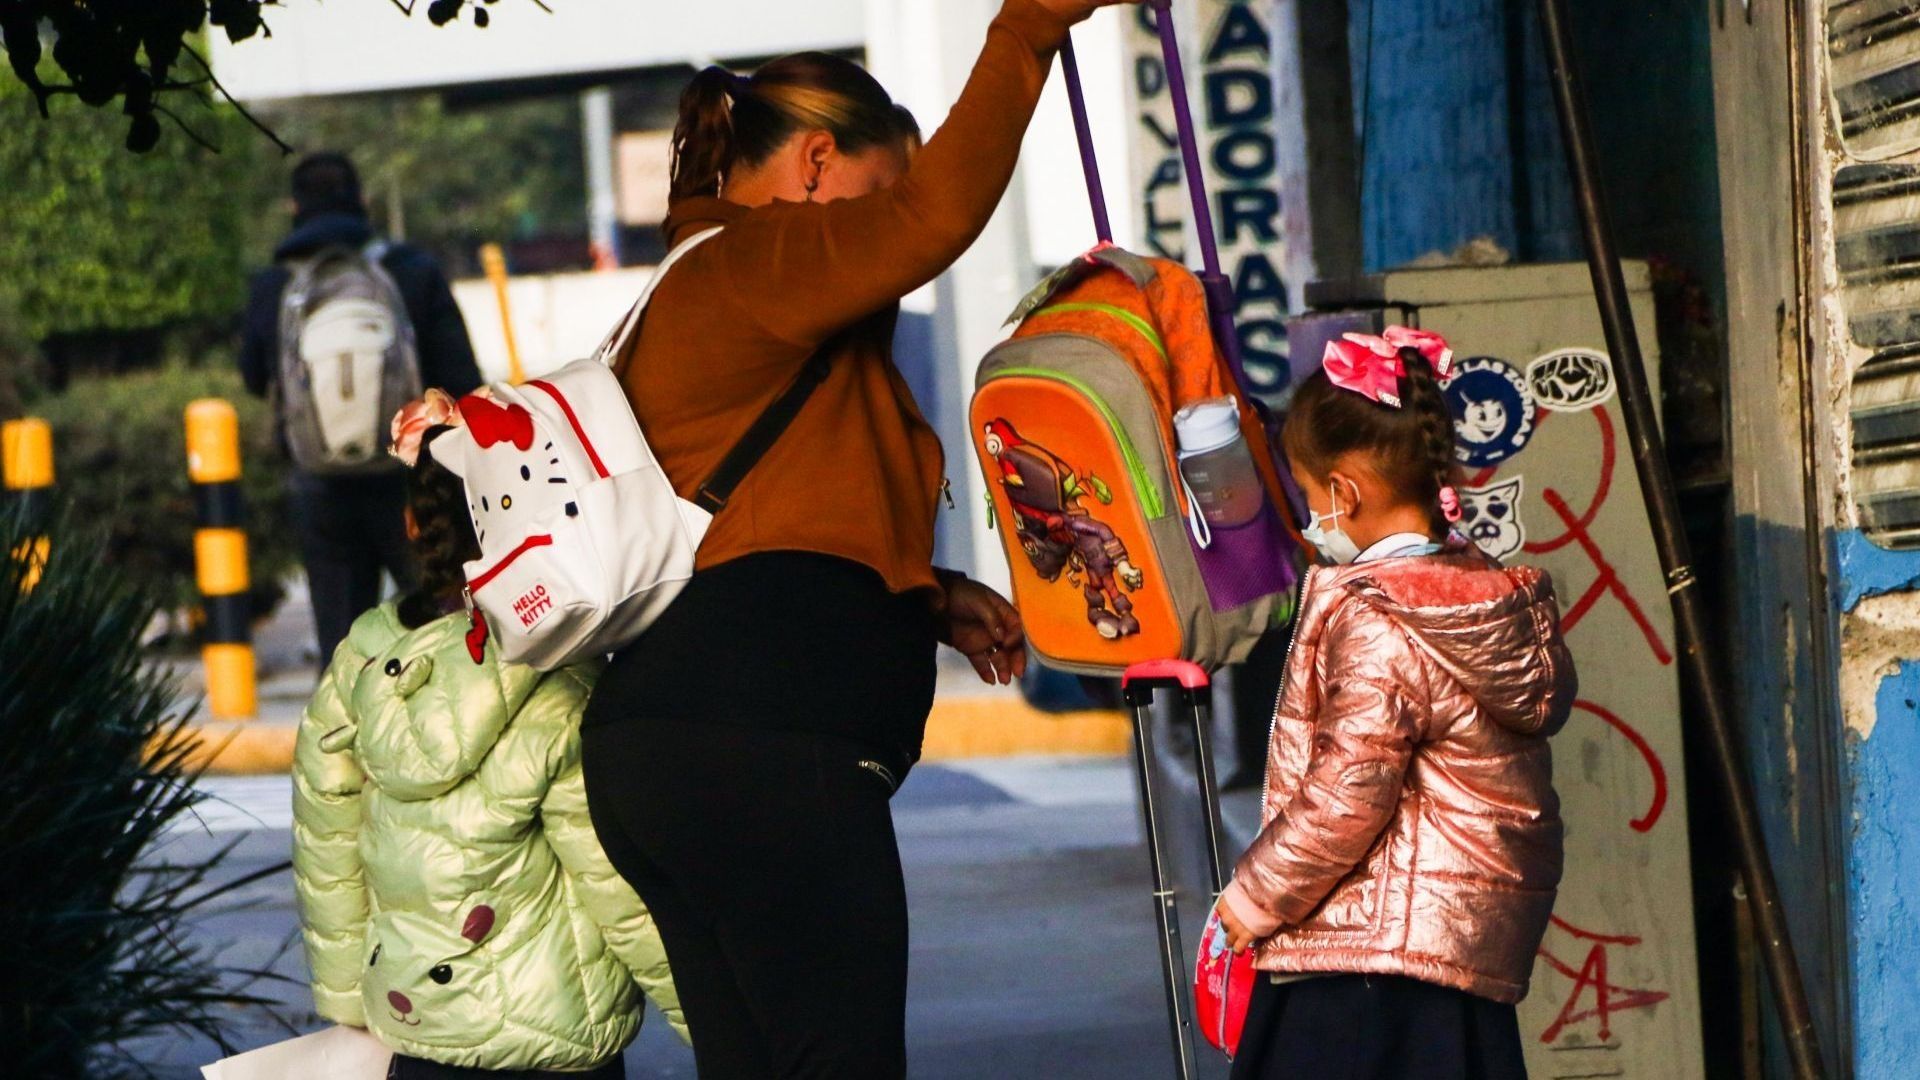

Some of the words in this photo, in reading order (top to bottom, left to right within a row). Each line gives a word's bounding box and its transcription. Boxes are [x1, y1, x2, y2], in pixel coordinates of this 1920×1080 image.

[1205, 2, 1291, 395] ADORAS
[1463, 359, 1504, 374] LAS
[512, 584, 546, 615] HELLO
[520, 595, 552, 628] KITTY
